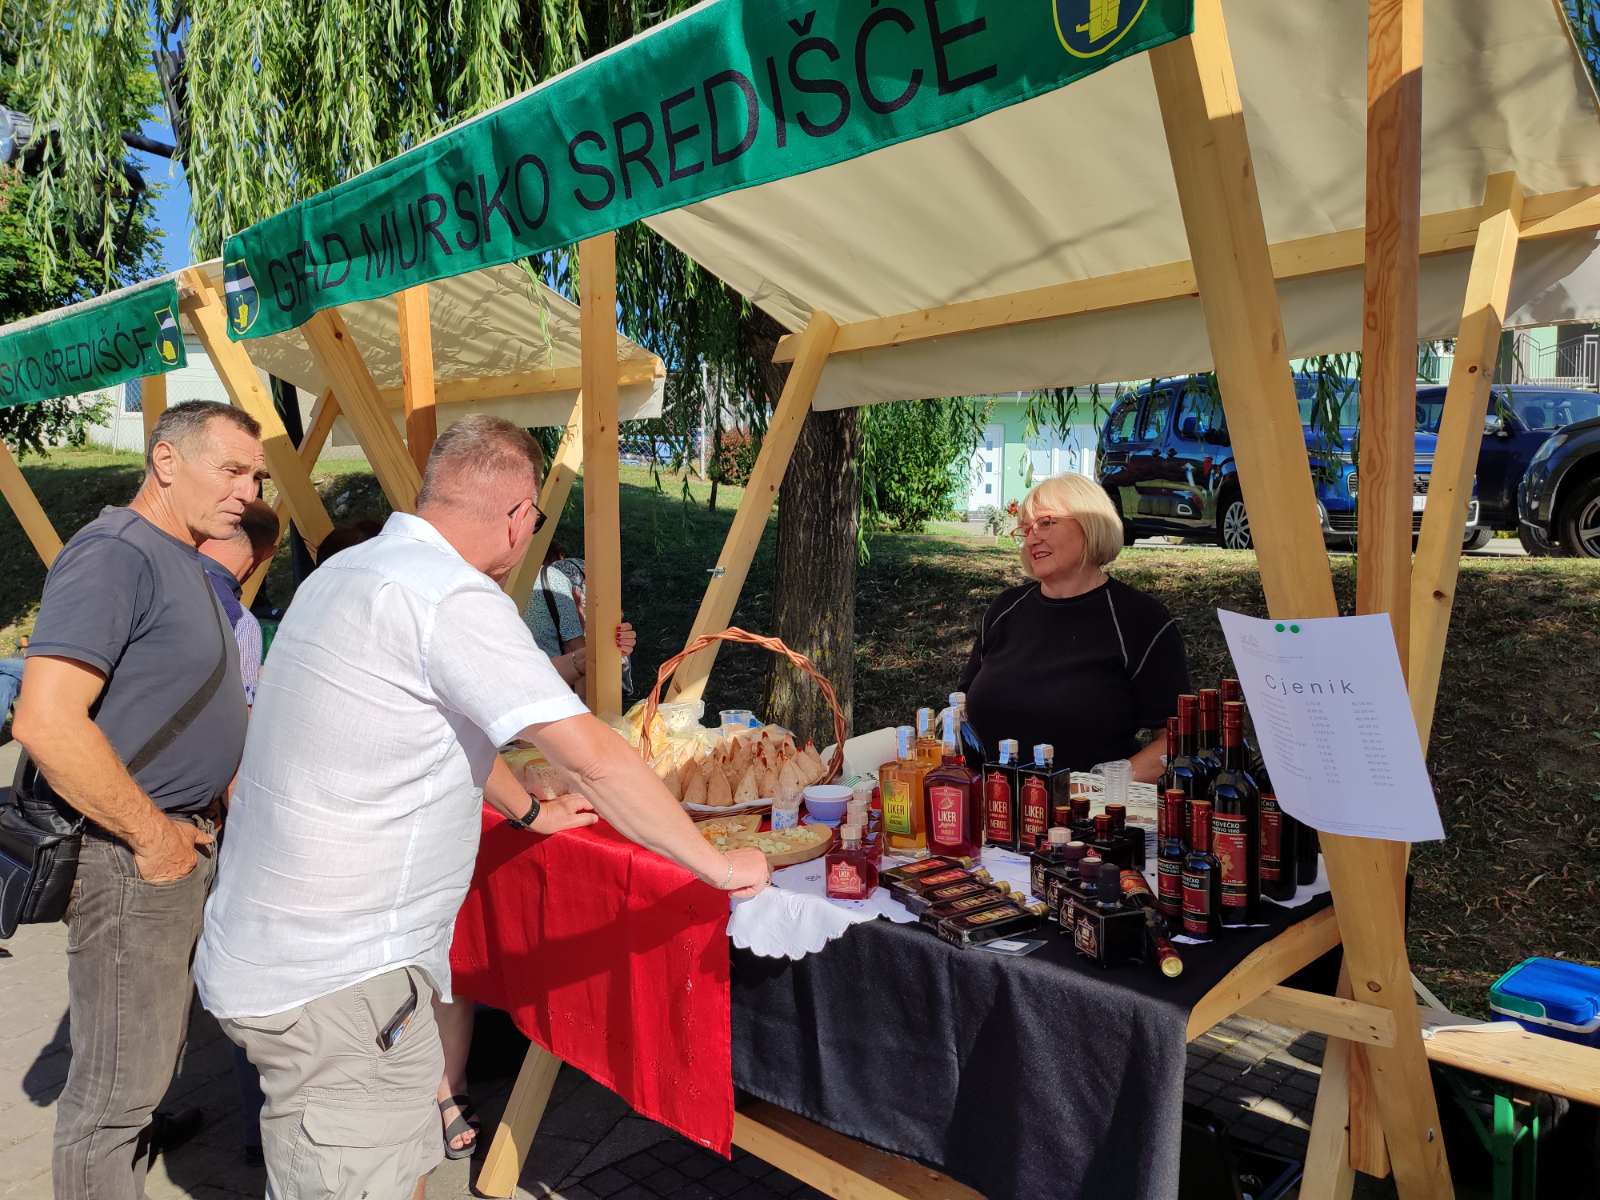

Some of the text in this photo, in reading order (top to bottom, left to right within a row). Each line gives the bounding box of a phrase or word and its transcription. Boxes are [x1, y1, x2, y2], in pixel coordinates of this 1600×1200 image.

[359, 153, 550, 282] MURSKO
[568, 0, 998, 212] SREDIŠĆE
[0, 356, 42, 397] SKO
[1263, 673, 1357, 696] Cjenik
[887, 803, 905, 816] LIKER
[988, 800, 1008, 814] LIKER
[1024, 804, 1044, 819] LIKER
[937, 811, 957, 824] LIKER
